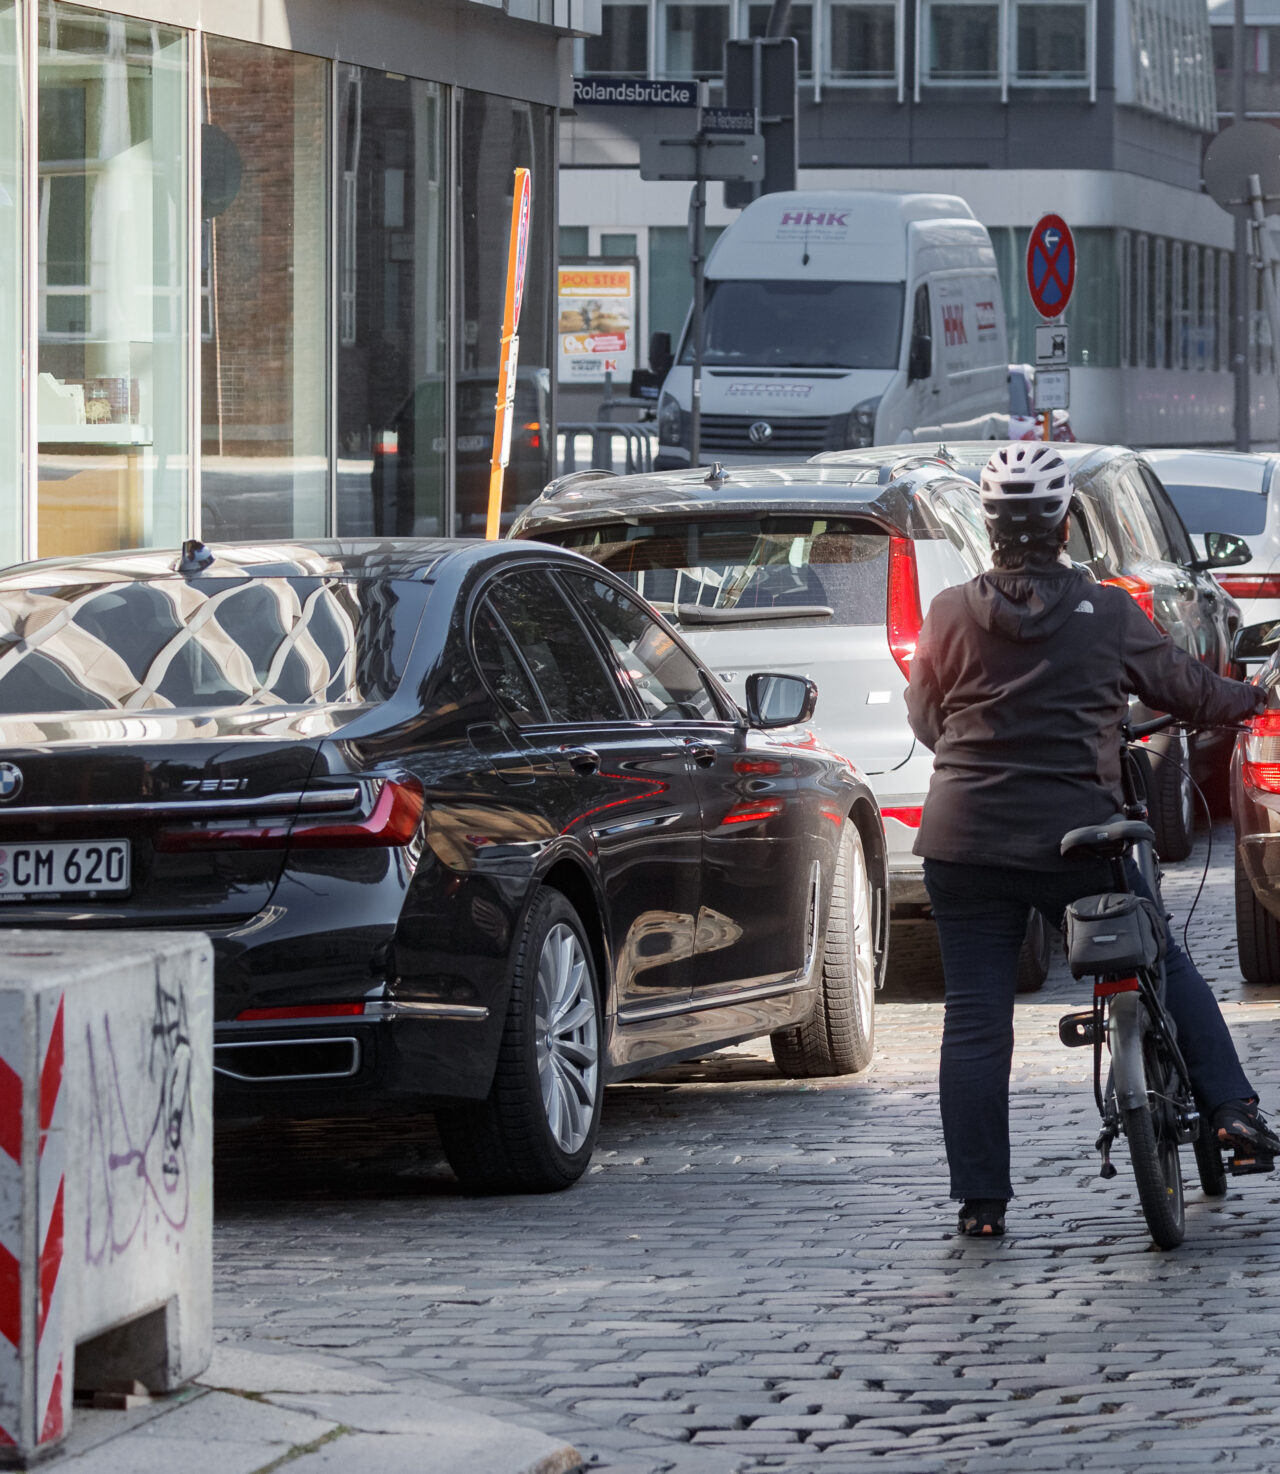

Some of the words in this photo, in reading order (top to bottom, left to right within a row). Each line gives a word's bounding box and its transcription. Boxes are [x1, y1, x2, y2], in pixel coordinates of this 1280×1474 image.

[573, 81, 690, 103] Rolandsbrücke
[780, 212, 849, 227] HHK
[561, 273, 627, 286] POLSTER
[942, 304, 968, 347] HHK
[12, 849, 54, 887] CM
[63, 846, 125, 885] 620
